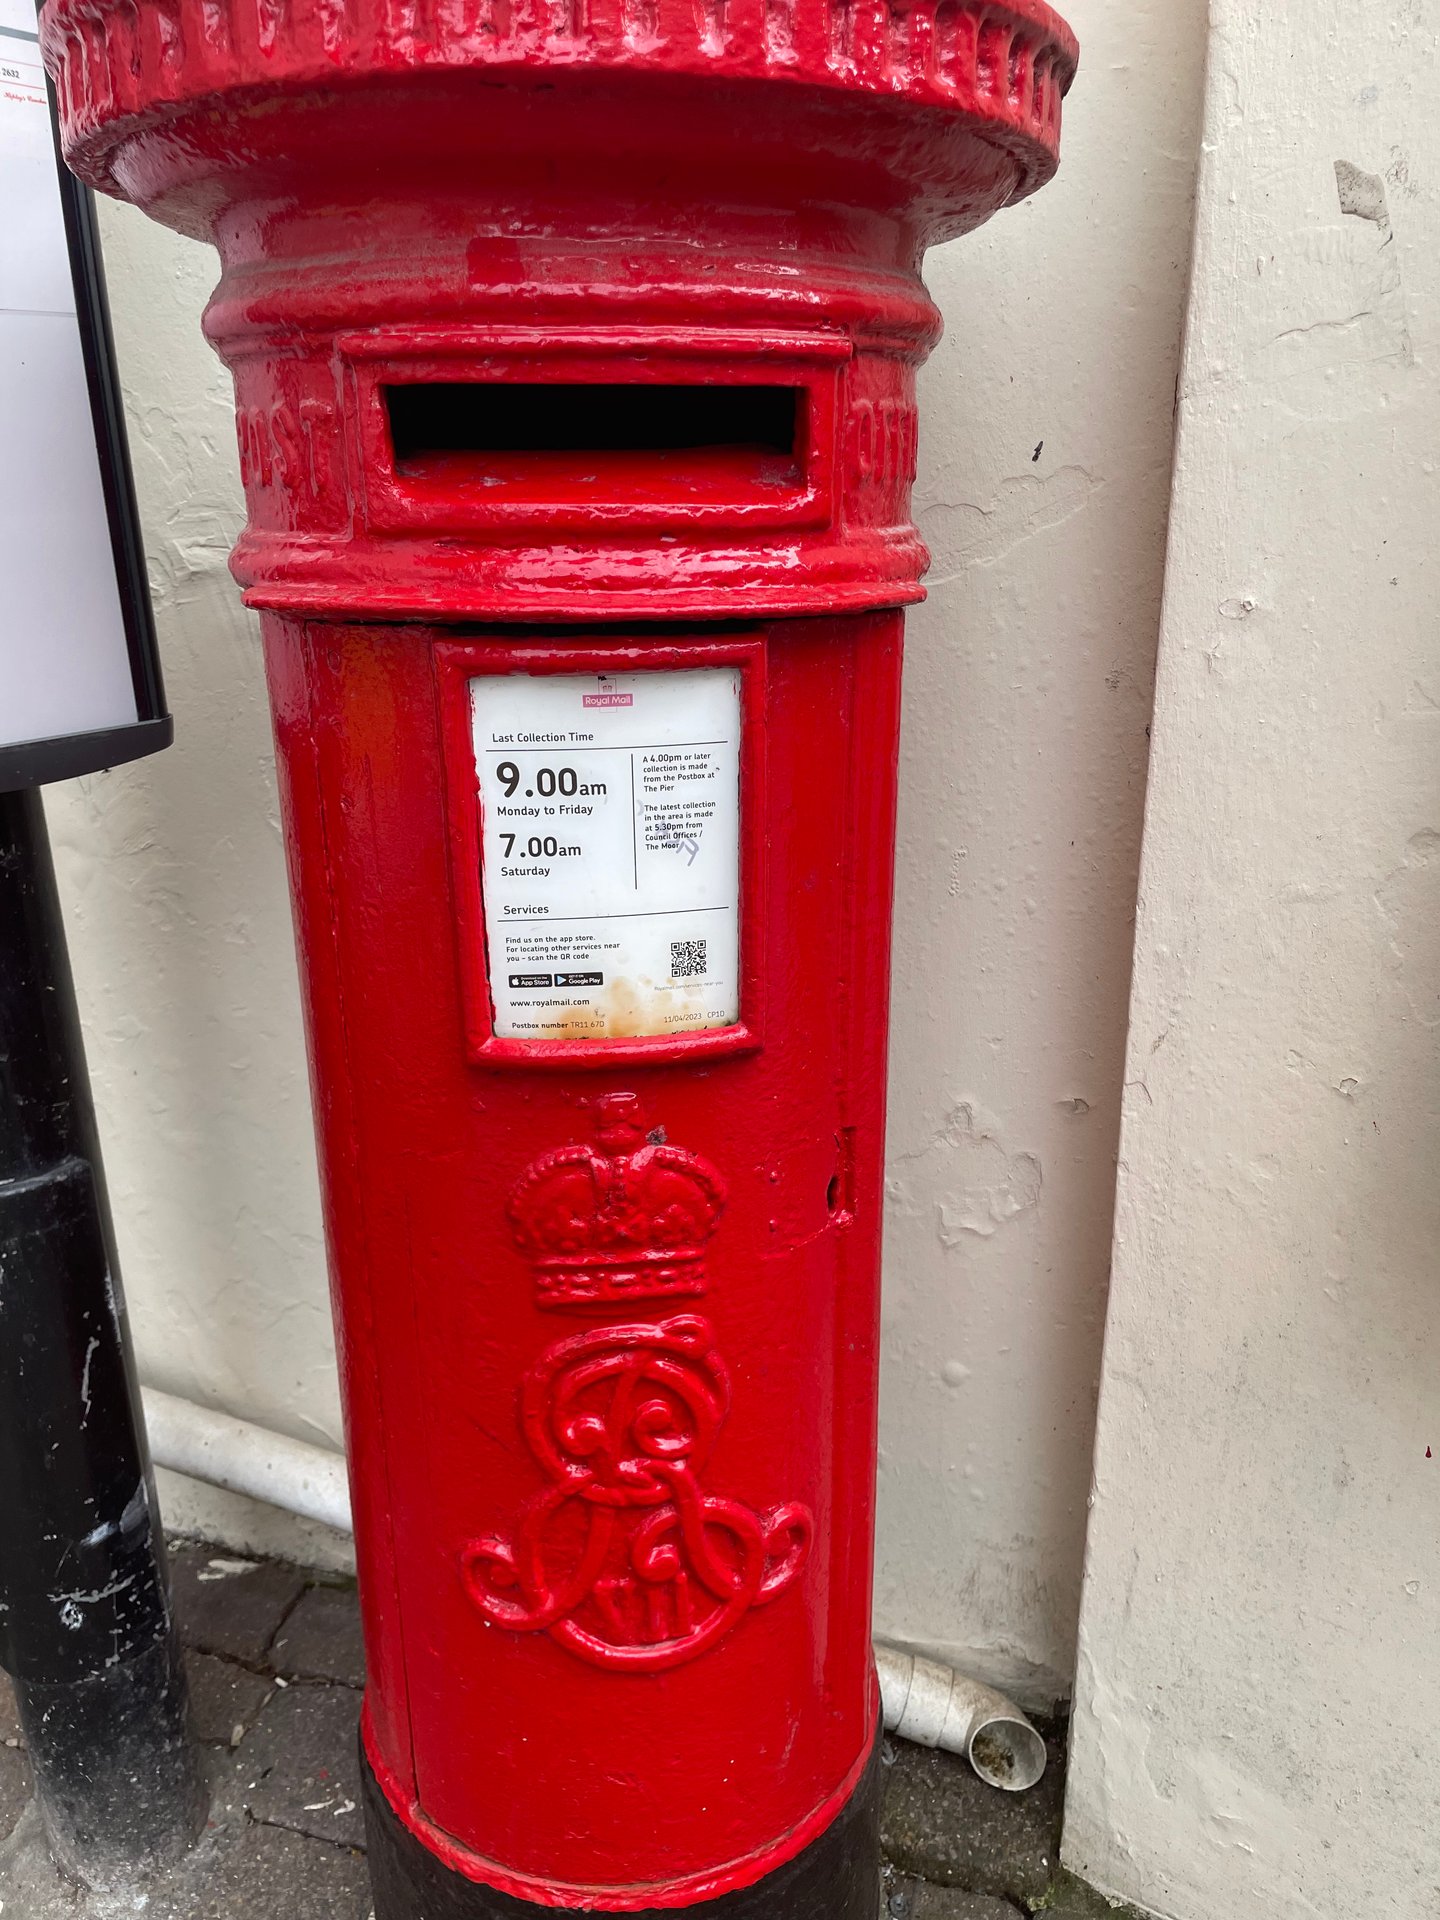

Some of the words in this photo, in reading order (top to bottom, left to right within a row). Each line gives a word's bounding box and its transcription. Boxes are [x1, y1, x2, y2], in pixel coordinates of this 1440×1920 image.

[585, 697, 610, 706] Royal
[611, 695, 632, 704] Mail
[492, 733, 514, 743] Last
[517, 732, 566, 742] Collection
[568, 732, 594, 741] Time
[650, 754, 682, 763] 4.00pm
[643, 764, 678, 773] collection
[496, 761, 607, 798] 9.00am
[643, 775, 661, 783] from
[663, 774, 676, 782] the
[659, 784, 675, 792] Pier
[497, 806, 540, 817] Monday
[544, 806, 555, 815] to
[559, 804, 593, 816] Friday
[644, 804, 658, 812] The
[660, 803, 681, 811] latest
[682, 801, 716, 809] collection
[653, 813, 666, 821] the
[667, 812, 684, 820] area
[694, 810, 714, 818] made
[645, 824, 653, 832] at
[654, 823, 684, 832] 5.30pm
[685, 821, 703, 829] from
[645, 833, 671, 842] Council
[673, 831, 698, 840] Offices
[498, 833, 582, 858] 7.00am
[661, 842, 680, 850] Moor
[500, 866, 551, 877] Saturday
[503, 905, 549, 915] Services
[520, 946, 549, 954] locating
[560, 953, 571, 961] QR
[509, 998, 590, 1008] www.royalmail.com
[664, 1013, 702, 1023] 11/04/2023
